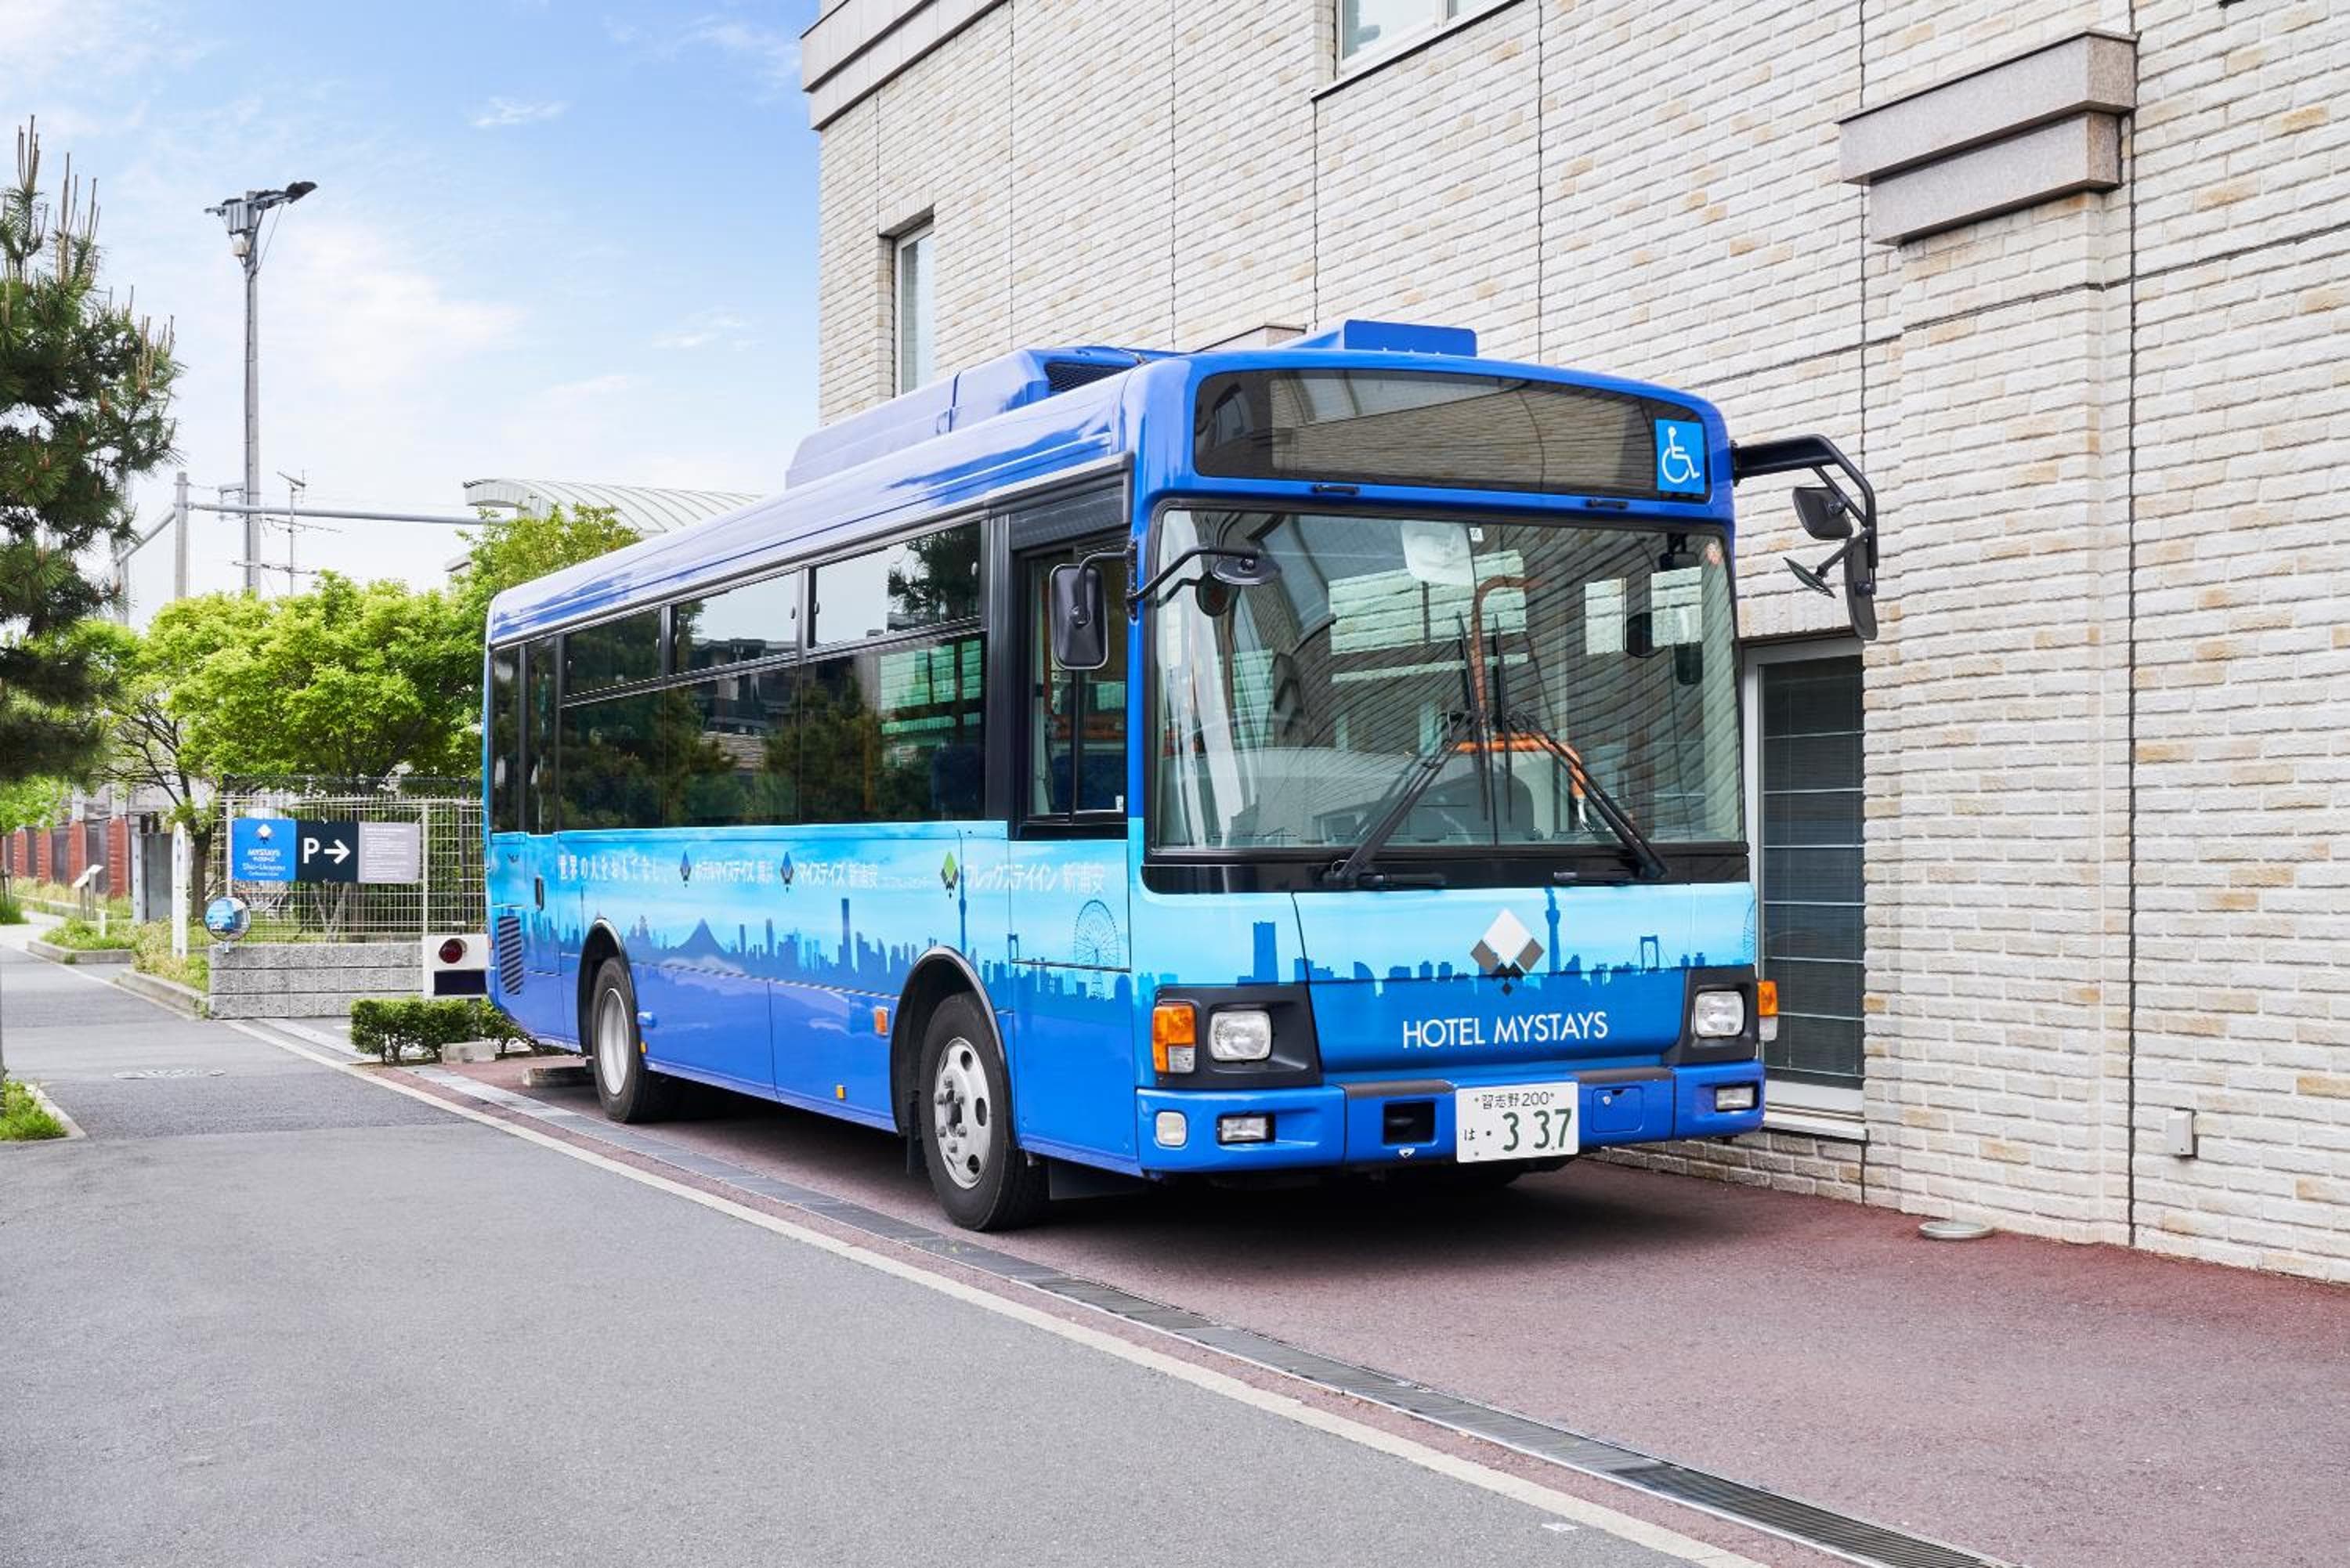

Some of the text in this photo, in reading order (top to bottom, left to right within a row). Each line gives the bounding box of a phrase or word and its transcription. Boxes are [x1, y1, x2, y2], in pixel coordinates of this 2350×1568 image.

[303, 837, 320, 864] P
[1403, 1011, 1609, 1049] HOTEL MYSTAYS
[1463, 1128, 1475, 1141] は
